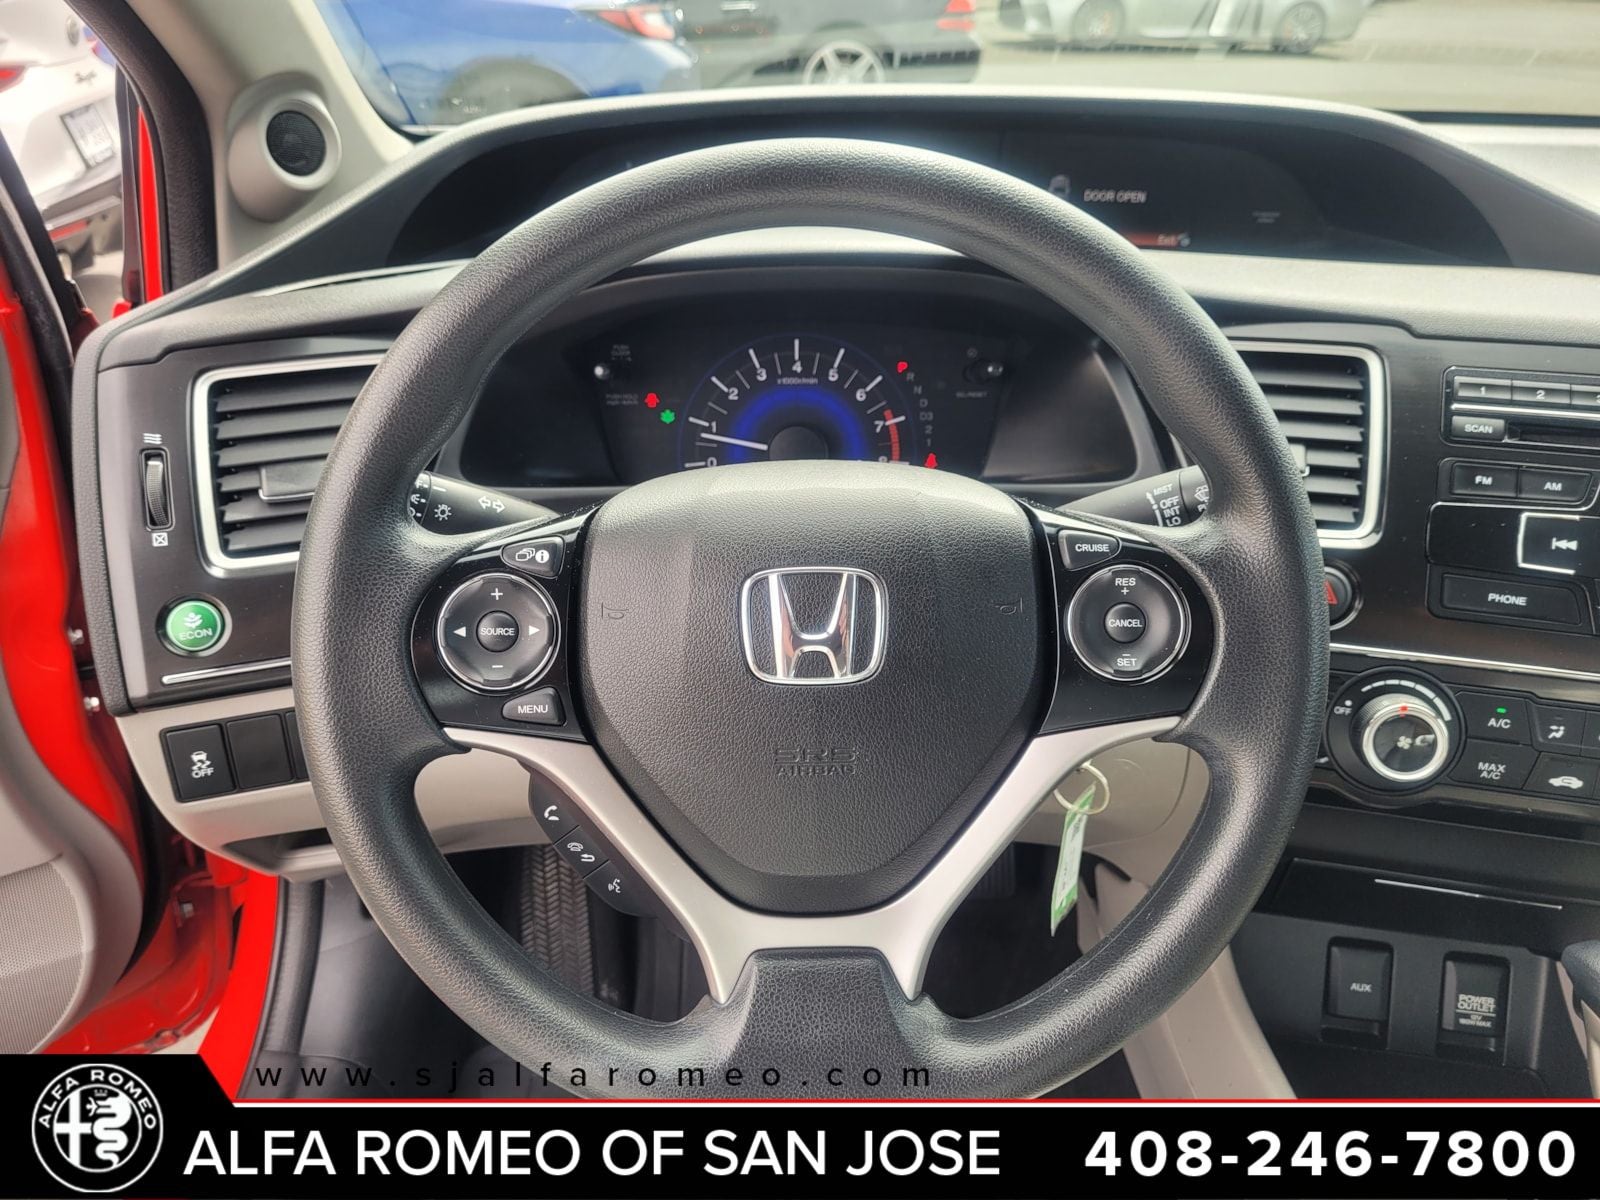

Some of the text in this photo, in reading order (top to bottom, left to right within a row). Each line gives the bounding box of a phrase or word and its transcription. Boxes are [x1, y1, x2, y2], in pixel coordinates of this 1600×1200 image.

[1083, 189, 1147, 203] DOOR OPEN
[792, 360, 802, 373] 4
[896, 361, 908, 373] P
[756, 367, 767, 382] 3
[828, 367, 839, 382] 5
[728, 386, 739, 401] 2
[855, 387, 866, 402] 6
[1479, 386, 1487, 396] 1
[1535, 389, 1546, 400] 2
[710, 420, 718, 434] 1
[873, 420, 884, 433] 7
[1464, 423, 1493, 434] SCAN
[1474, 475, 1493, 486] FM
[1543, 481, 1563, 492] AM
[1154, 485, 1173, 496] MIST
[1159, 496, 1180, 508] OFF
[1163, 506, 1181, 518] INT
[1165, 516, 1182, 528] LO
[1075, 542, 1110, 553] CRUISE
[1115, 577, 1137, 587] RES
[1488, 592, 1528, 606] PHONE
[1108, 618, 1142, 629] CANCEL
[178, 627, 213, 641] ECON
[480, 626, 515, 637] SOURCE
[1117, 657, 1136, 668] SET
[517, 704, 549, 715] MENU
[1487, 717, 1512, 730] A/C
[191, 767, 215, 779] OFF
[1477, 761, 1506, 774] MAX
[1480, 770, 1502, 781] A/C
[1350, 983, 1372, 993] AUX
[1458, 994, 1496, 1005] POWER
[1458, 1002, 1496, 1012] OUTLET
